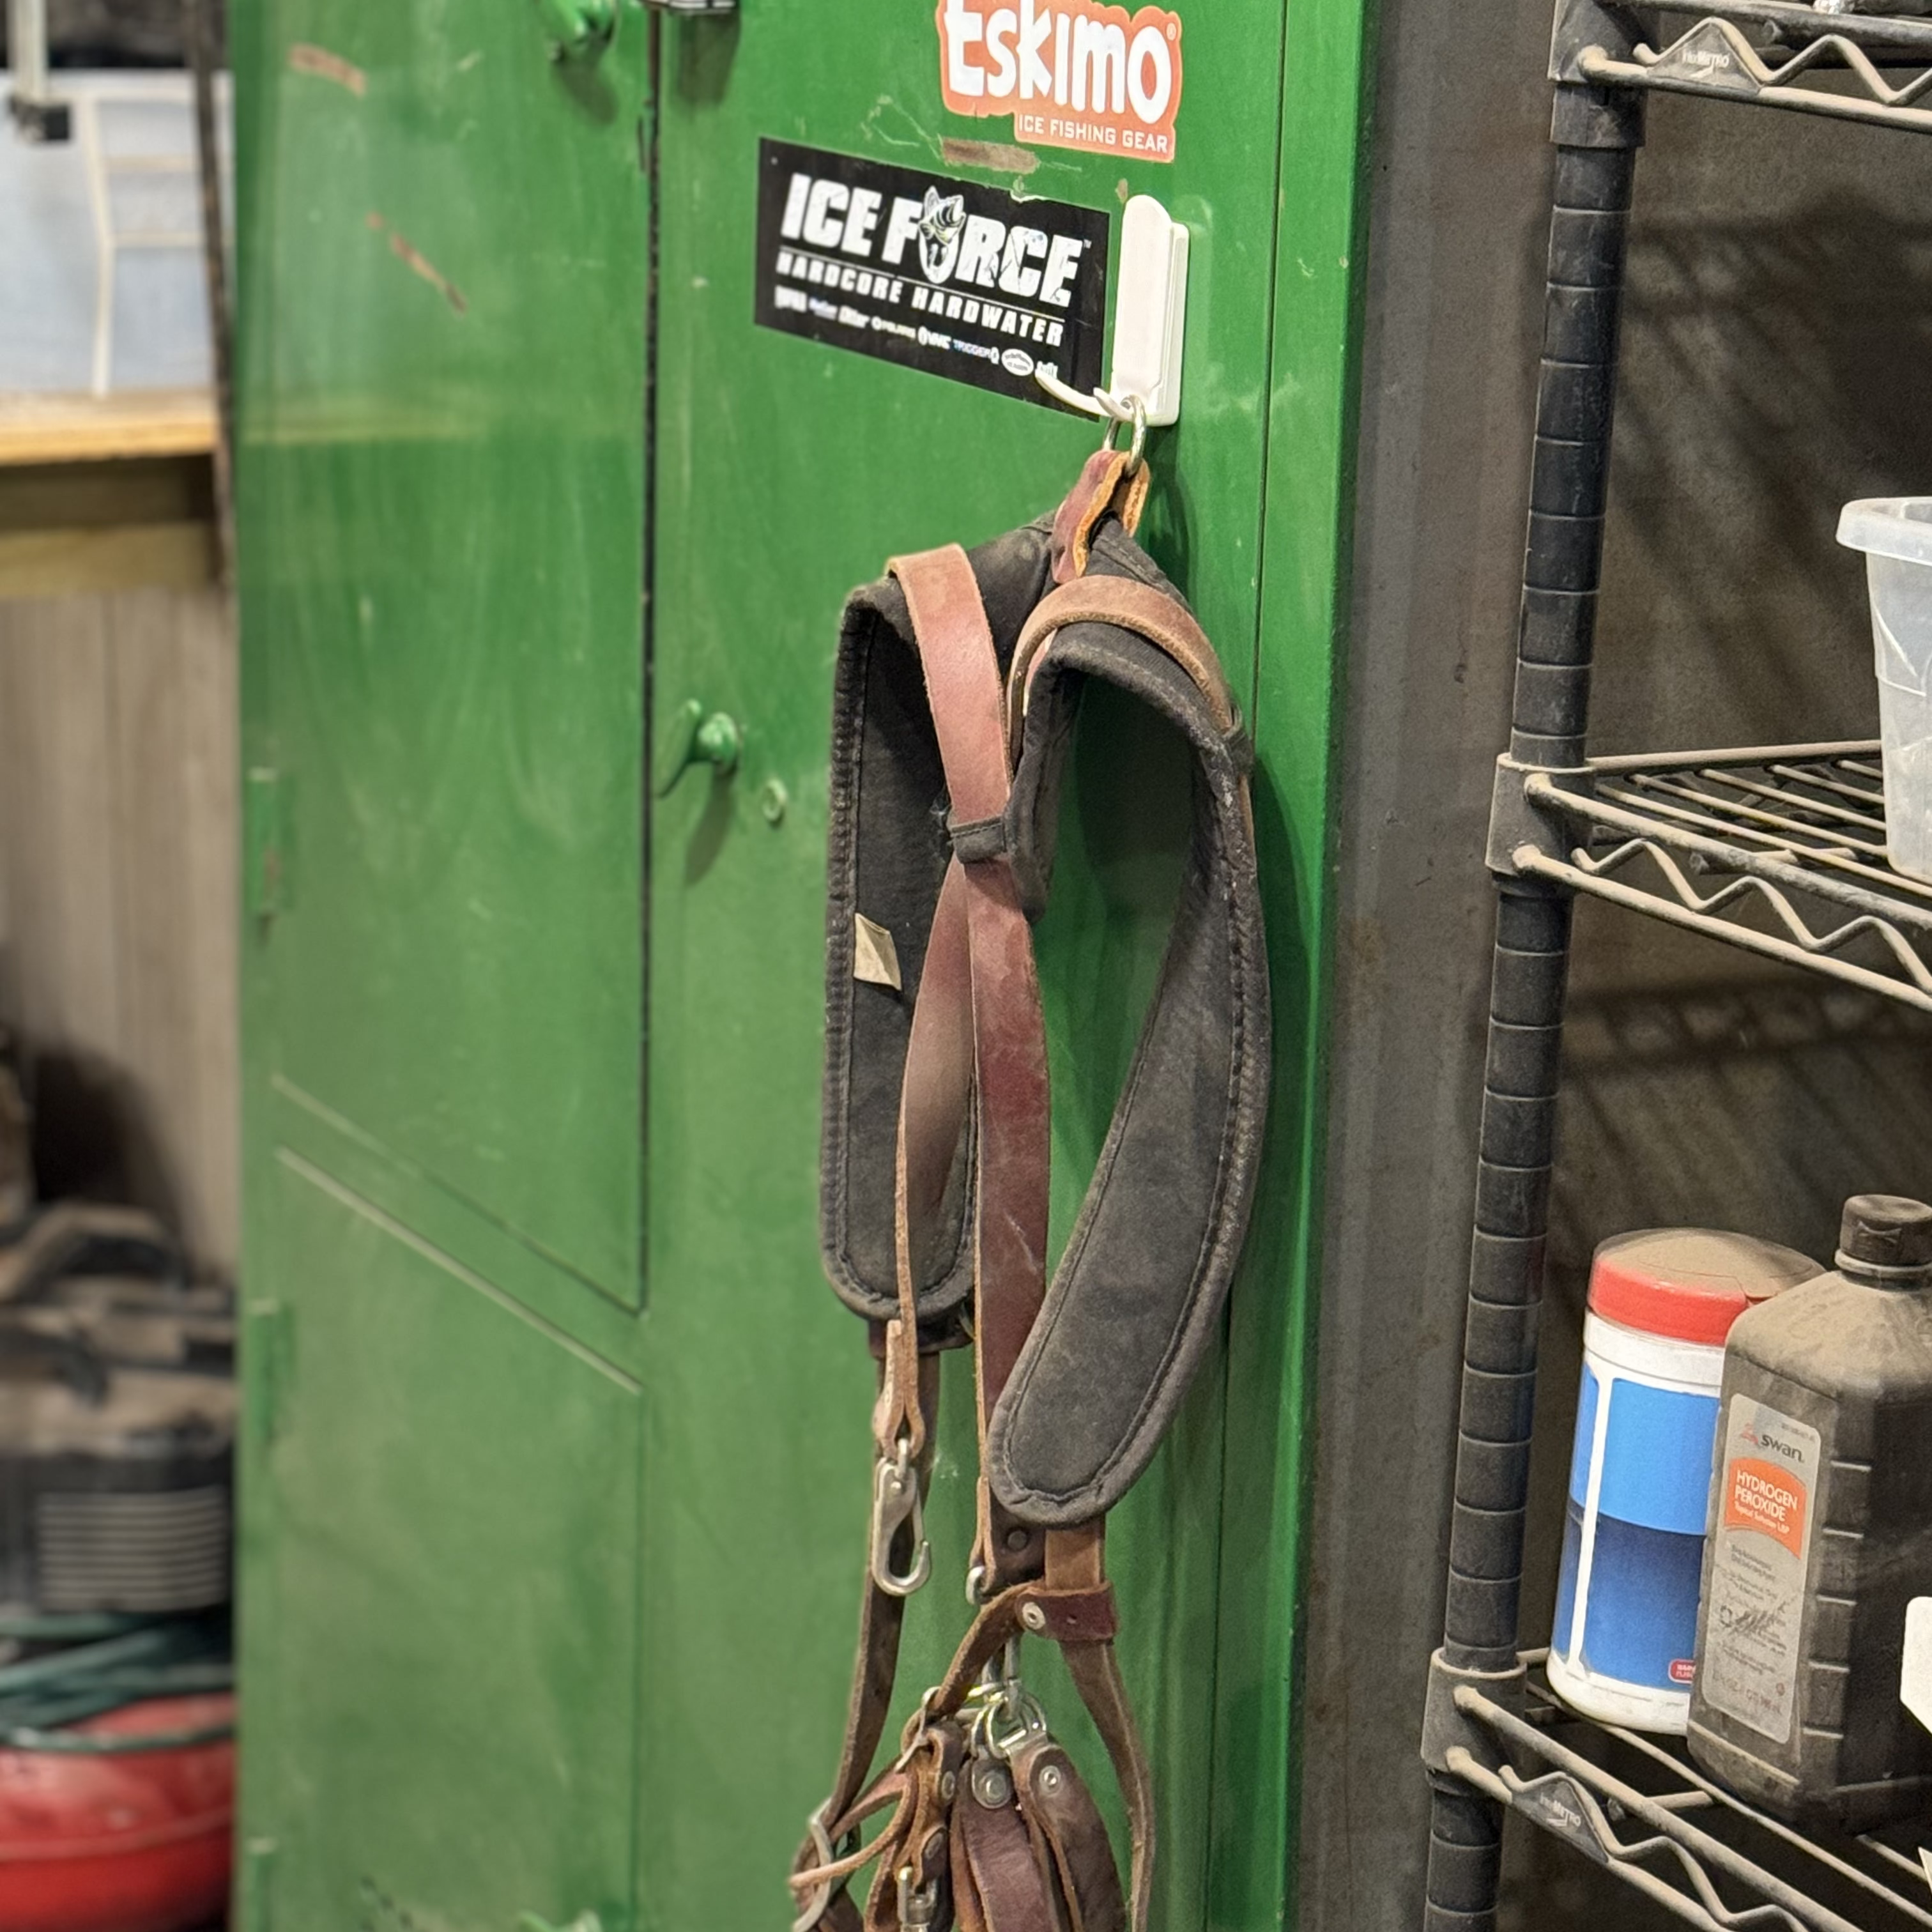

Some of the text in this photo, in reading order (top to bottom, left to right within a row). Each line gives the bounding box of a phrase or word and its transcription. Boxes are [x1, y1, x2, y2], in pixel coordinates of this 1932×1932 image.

[1018, 114, 1168, 153] ICE FISHING GEAR
[780, 172, 1084, 308] ICE FORCE
[775, 251, 903, 303] HARDCORE
[910, 286, 1065, 348] HARDWATER
[1761, 1434, 1802, 1462] swan
[1734, 1484, 1786, 1522] PEROXIDE
[1736, 1469, 1798, 1511] HYDROGEN
